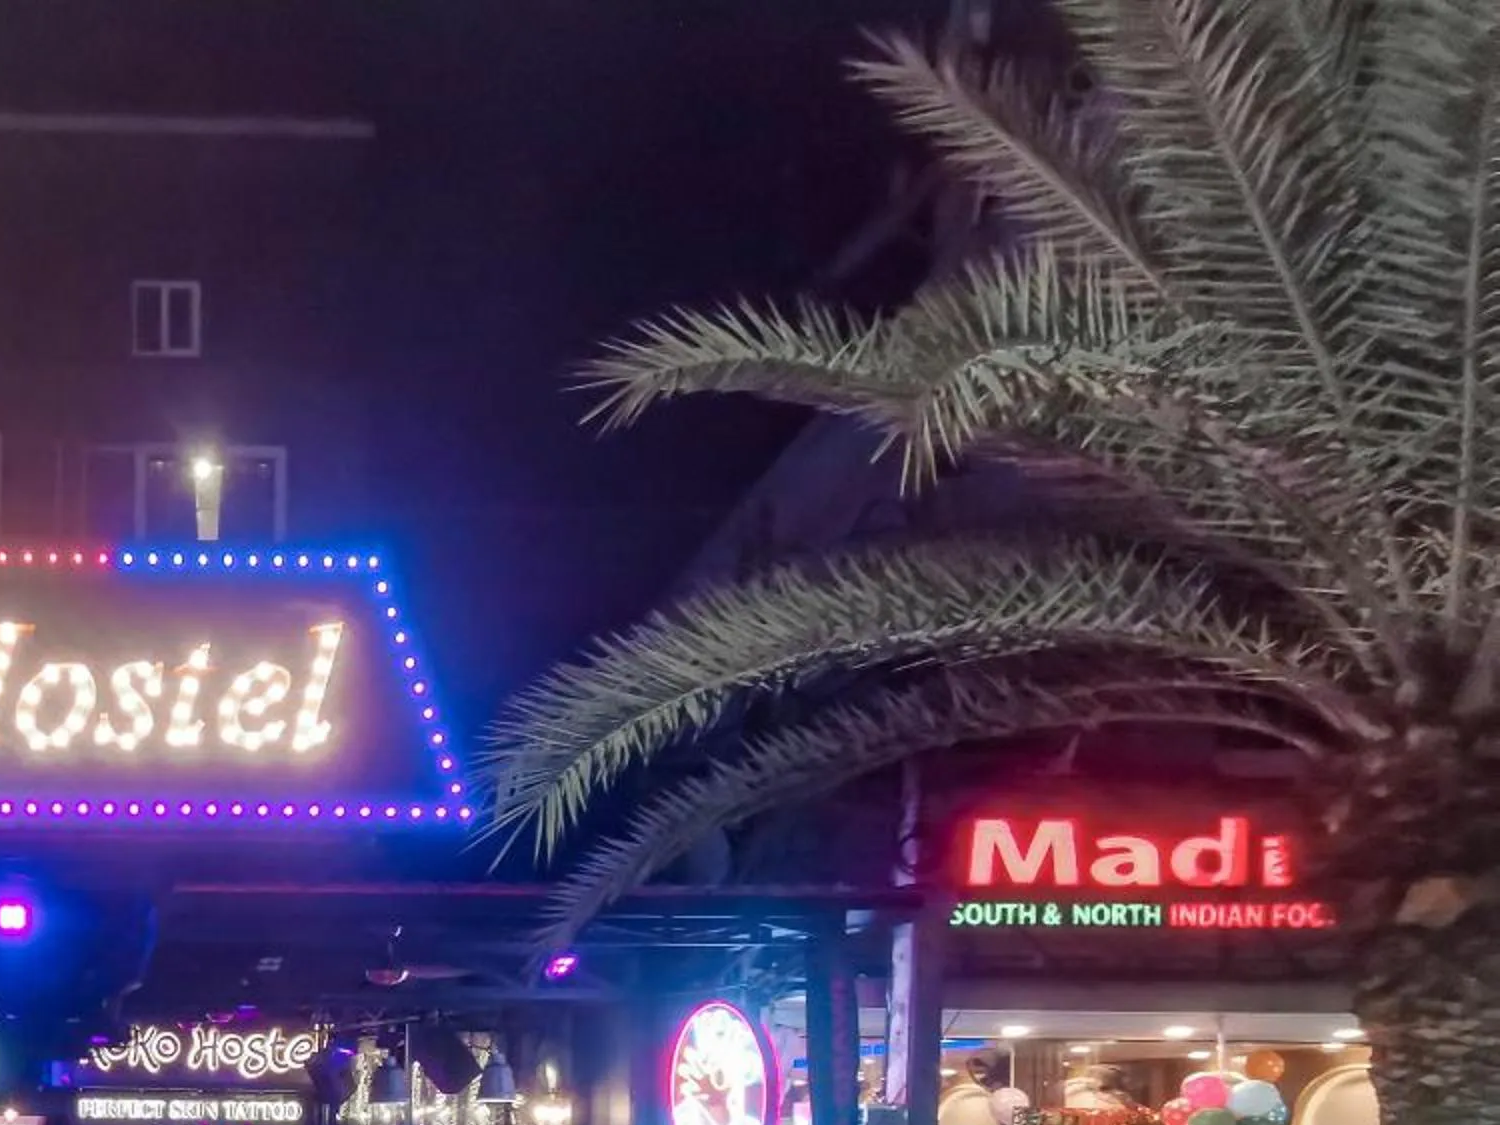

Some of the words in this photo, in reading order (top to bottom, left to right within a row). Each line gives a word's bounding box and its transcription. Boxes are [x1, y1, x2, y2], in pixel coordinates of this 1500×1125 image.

[950, 902, 1036, 928] SOUTH
[1042, 903, 1062, 928] &
[1073, 902, 1162, 928] NORTH
[1170, 902, 1267, 929] INDIAN
[77, 1097, 166, 1120] PERFECT
[168, 1099, 218, 1120] SKIN
[222, 1099, 303, 1121] TATTOO
